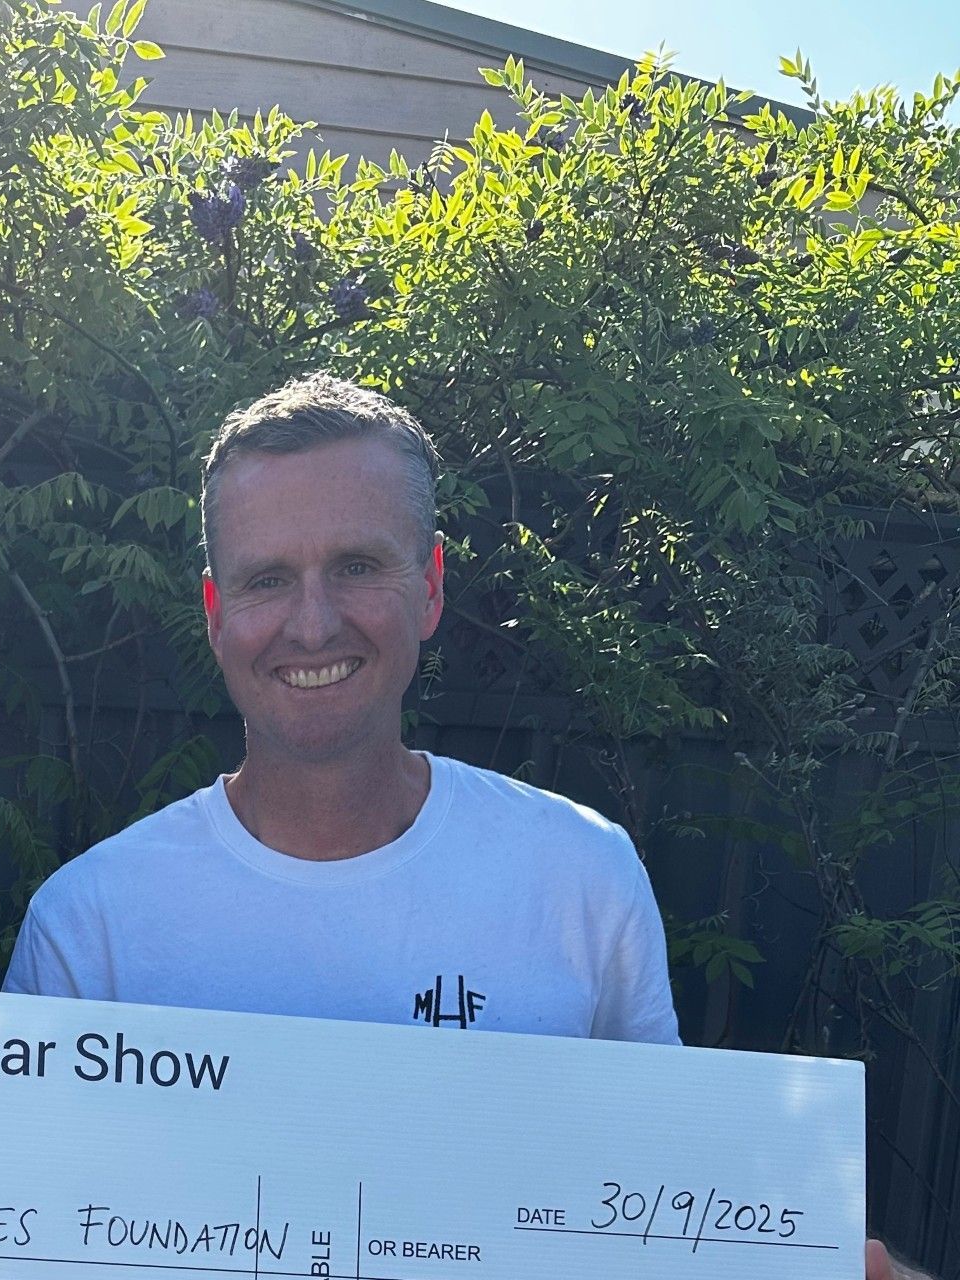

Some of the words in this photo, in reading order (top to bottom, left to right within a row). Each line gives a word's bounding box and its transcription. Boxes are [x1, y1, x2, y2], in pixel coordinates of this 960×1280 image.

[413, 975, 486, 1029] MHF
[74, 1032, 230, 1090] Show
[78, 1204, 289, 1260] FOUNDATION
[517, 1207, 566, 1226] DATE
[591, 1182, 804, 1254] 30/9/2025
[368, 1240, 397, 1257] OR
[402, 1242, 482, 1262] BEARER
